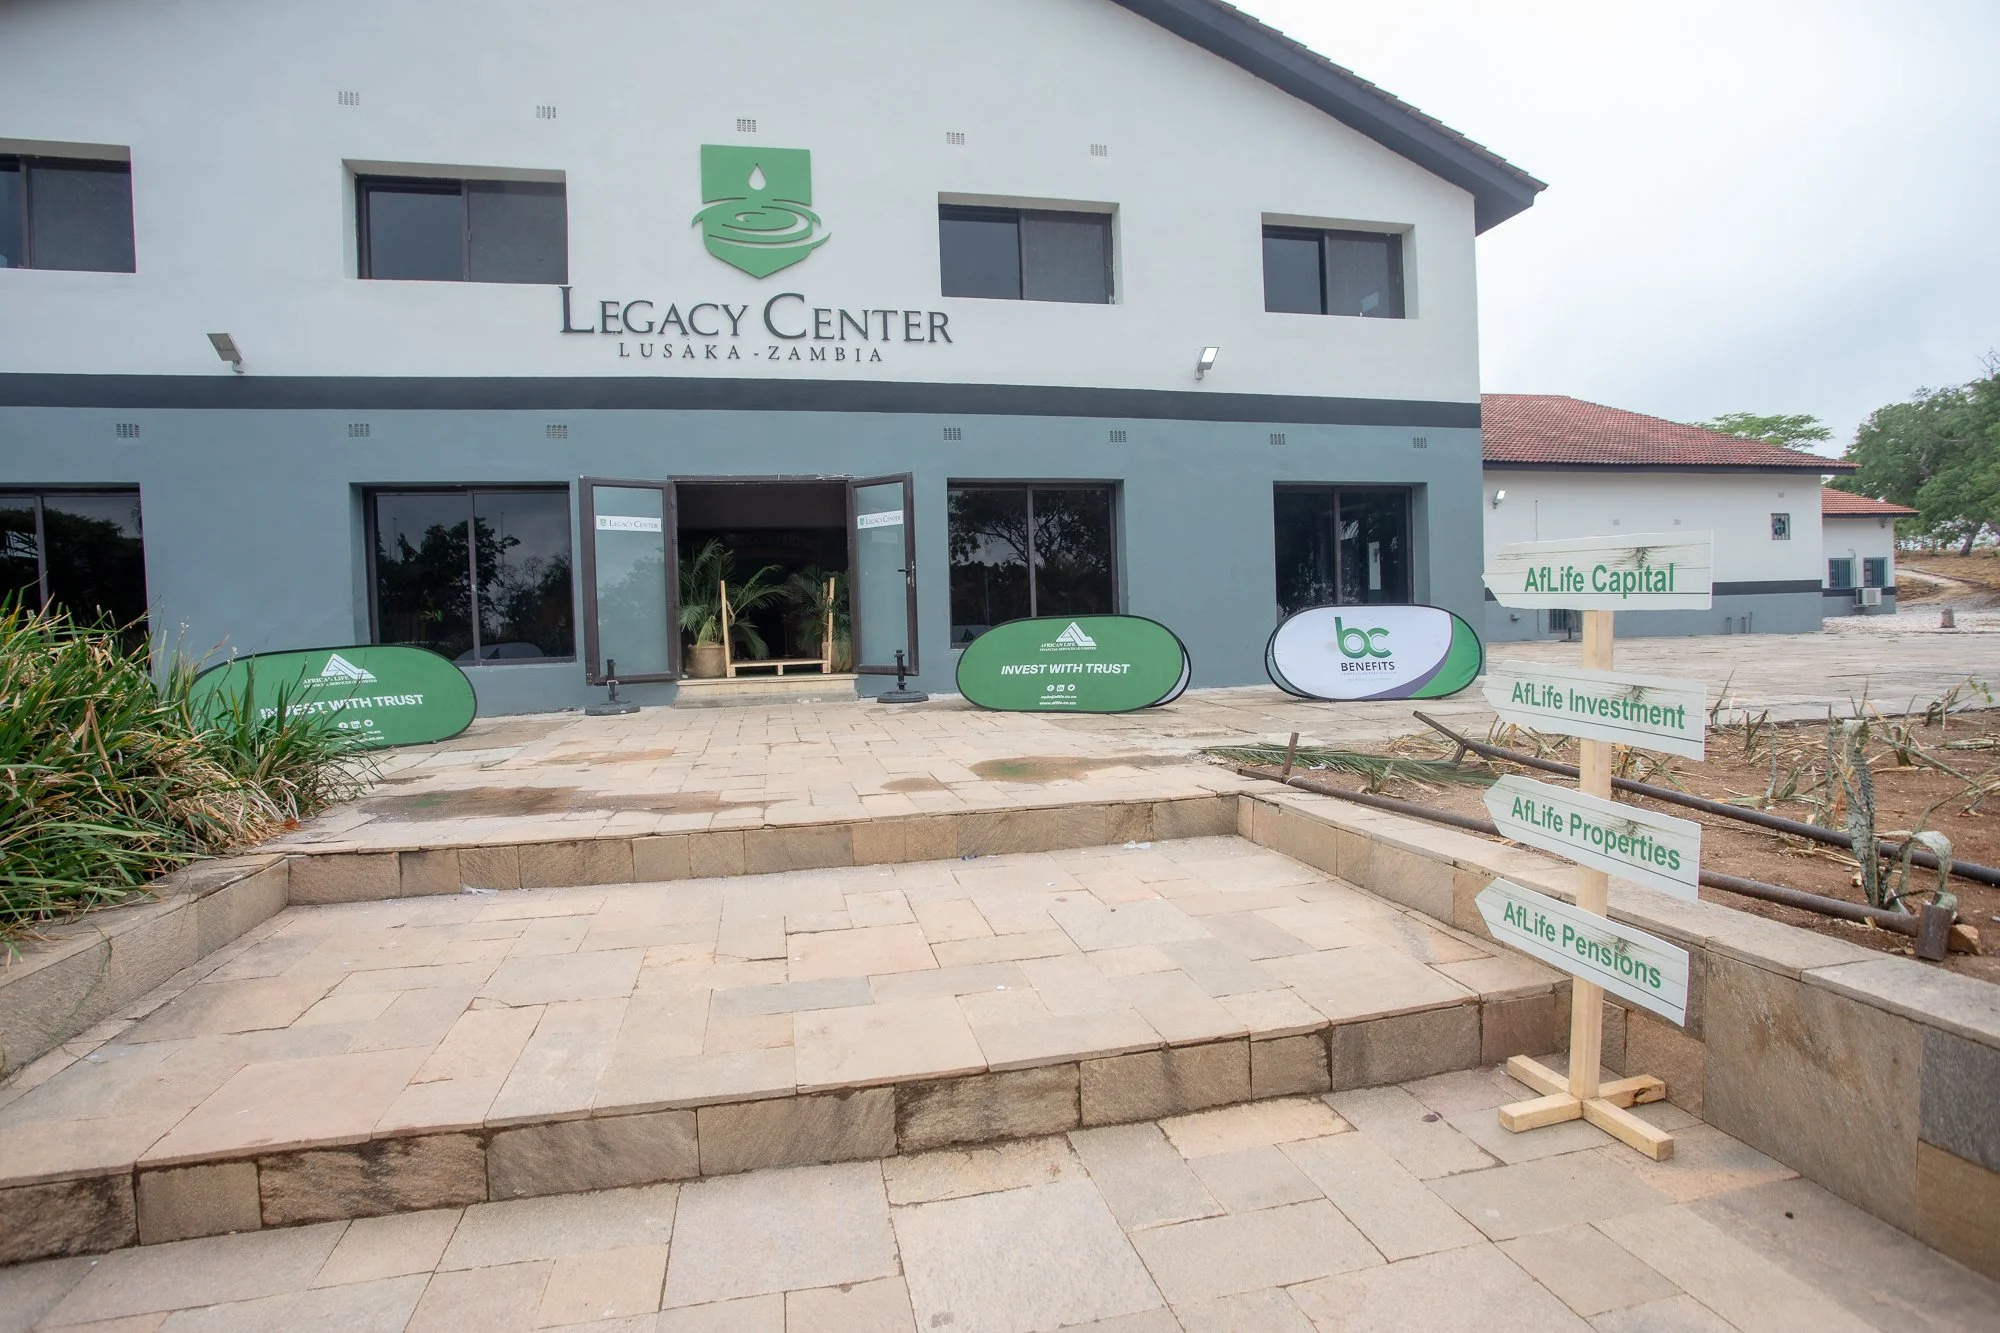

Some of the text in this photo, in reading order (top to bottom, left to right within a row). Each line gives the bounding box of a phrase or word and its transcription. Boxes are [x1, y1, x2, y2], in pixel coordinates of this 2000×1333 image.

[558, 285, 954, 344] LEGACY CENTER
[609, 519, 659, 529] LEGACY CENTER
[1524, 562, 1674, 599] AfLife Capital
[1000, 663, 1130, 675] INVEST WITH TRUST
[1340, 661, 1395, 672] BENEFITS
[327, 696, 373, 712] WITH
[376, 694, 424, 709] TRUST
[1511, 681, 1685, 730] AfLife Investment
[1511, 796, 1681, 871] AfLife Properties
[1503, 901, 1661, 989] AfLife Pensions
